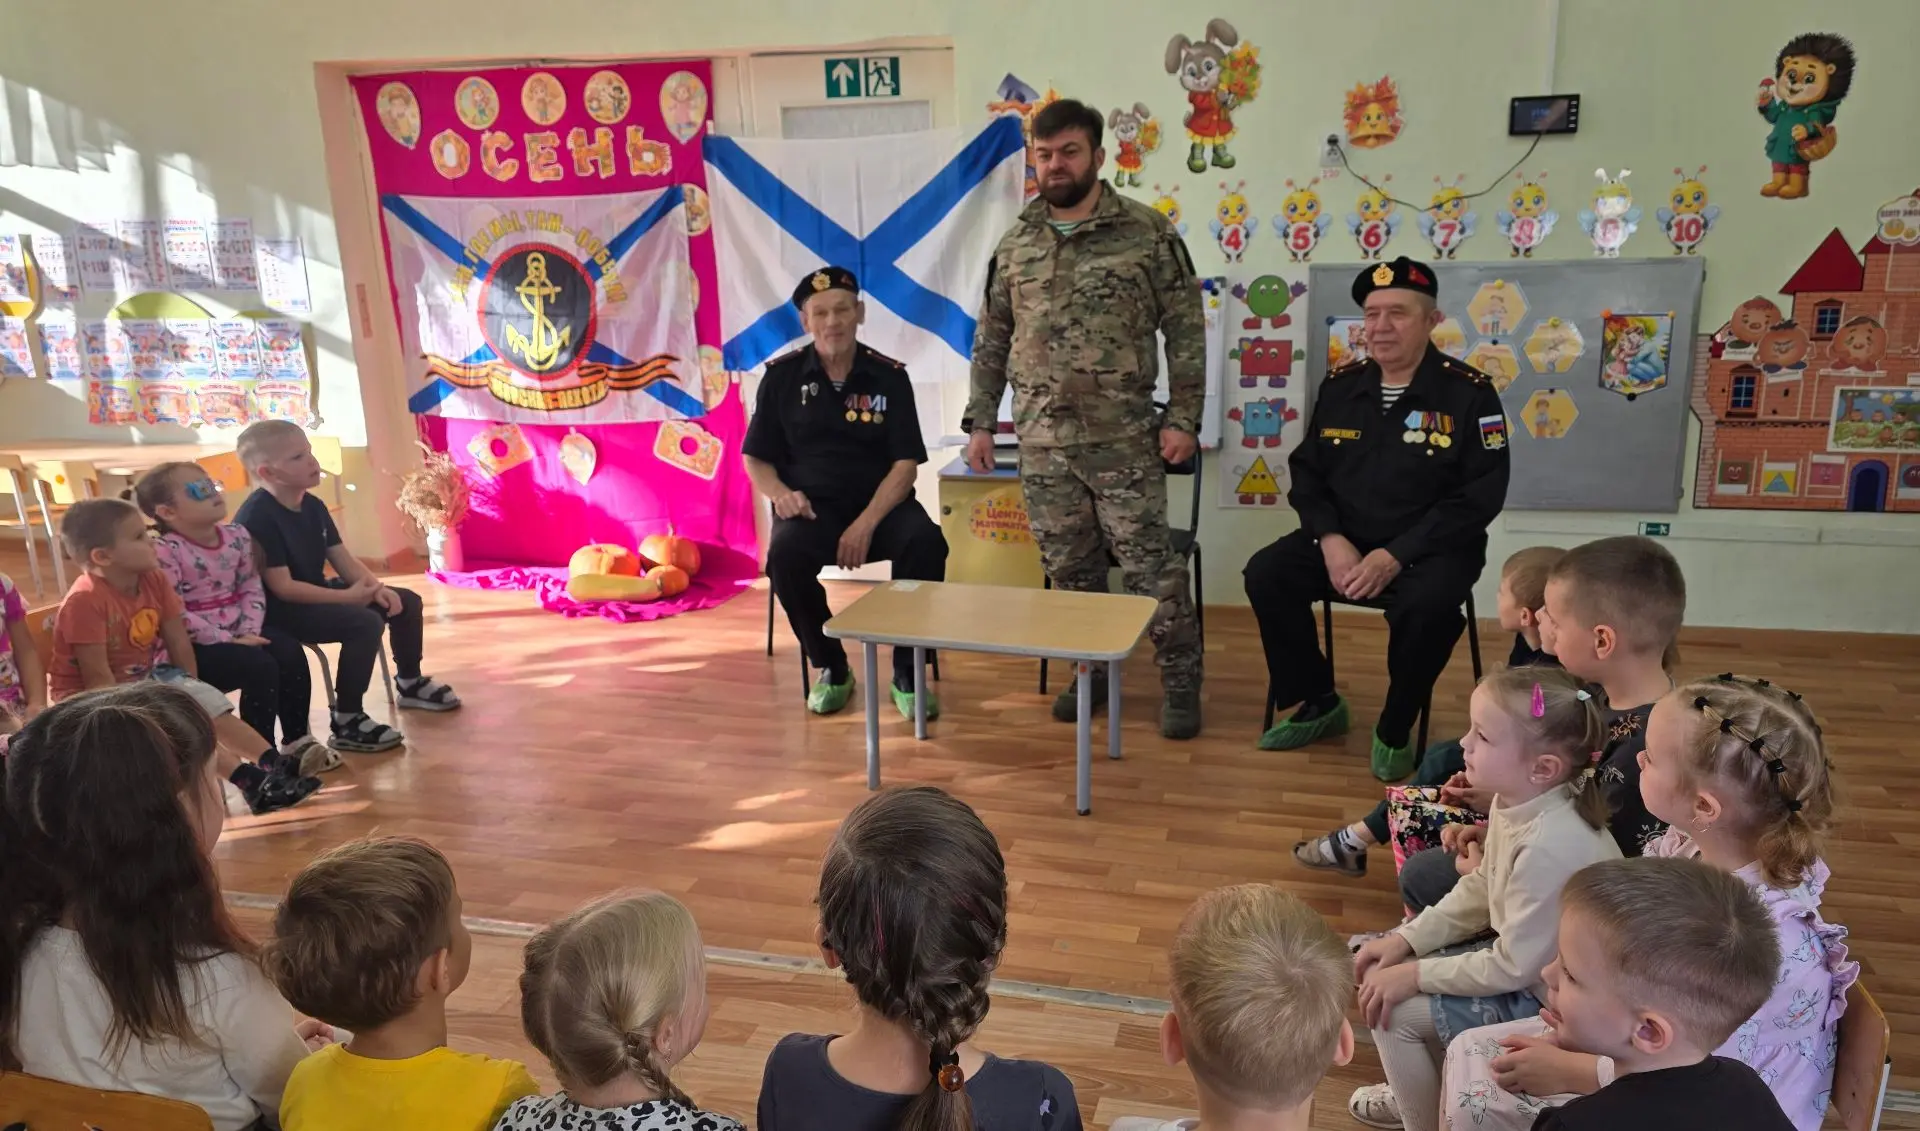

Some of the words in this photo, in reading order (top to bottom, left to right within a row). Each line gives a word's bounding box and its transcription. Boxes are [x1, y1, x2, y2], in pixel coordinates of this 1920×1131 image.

[430, 126, 672, 182] ОСЕНЬ
[525, 210, 562, 233] ТАМ
[1674, 218, 1701, 243] 10
[1225, 228, 1242, 250] 4
[1292, 226, 1312, 250] 5
[1363, 224, 1382, 249] 6
[1438, 223, 1457, 248] 7
[986, 508, 1028, 522] Центр
